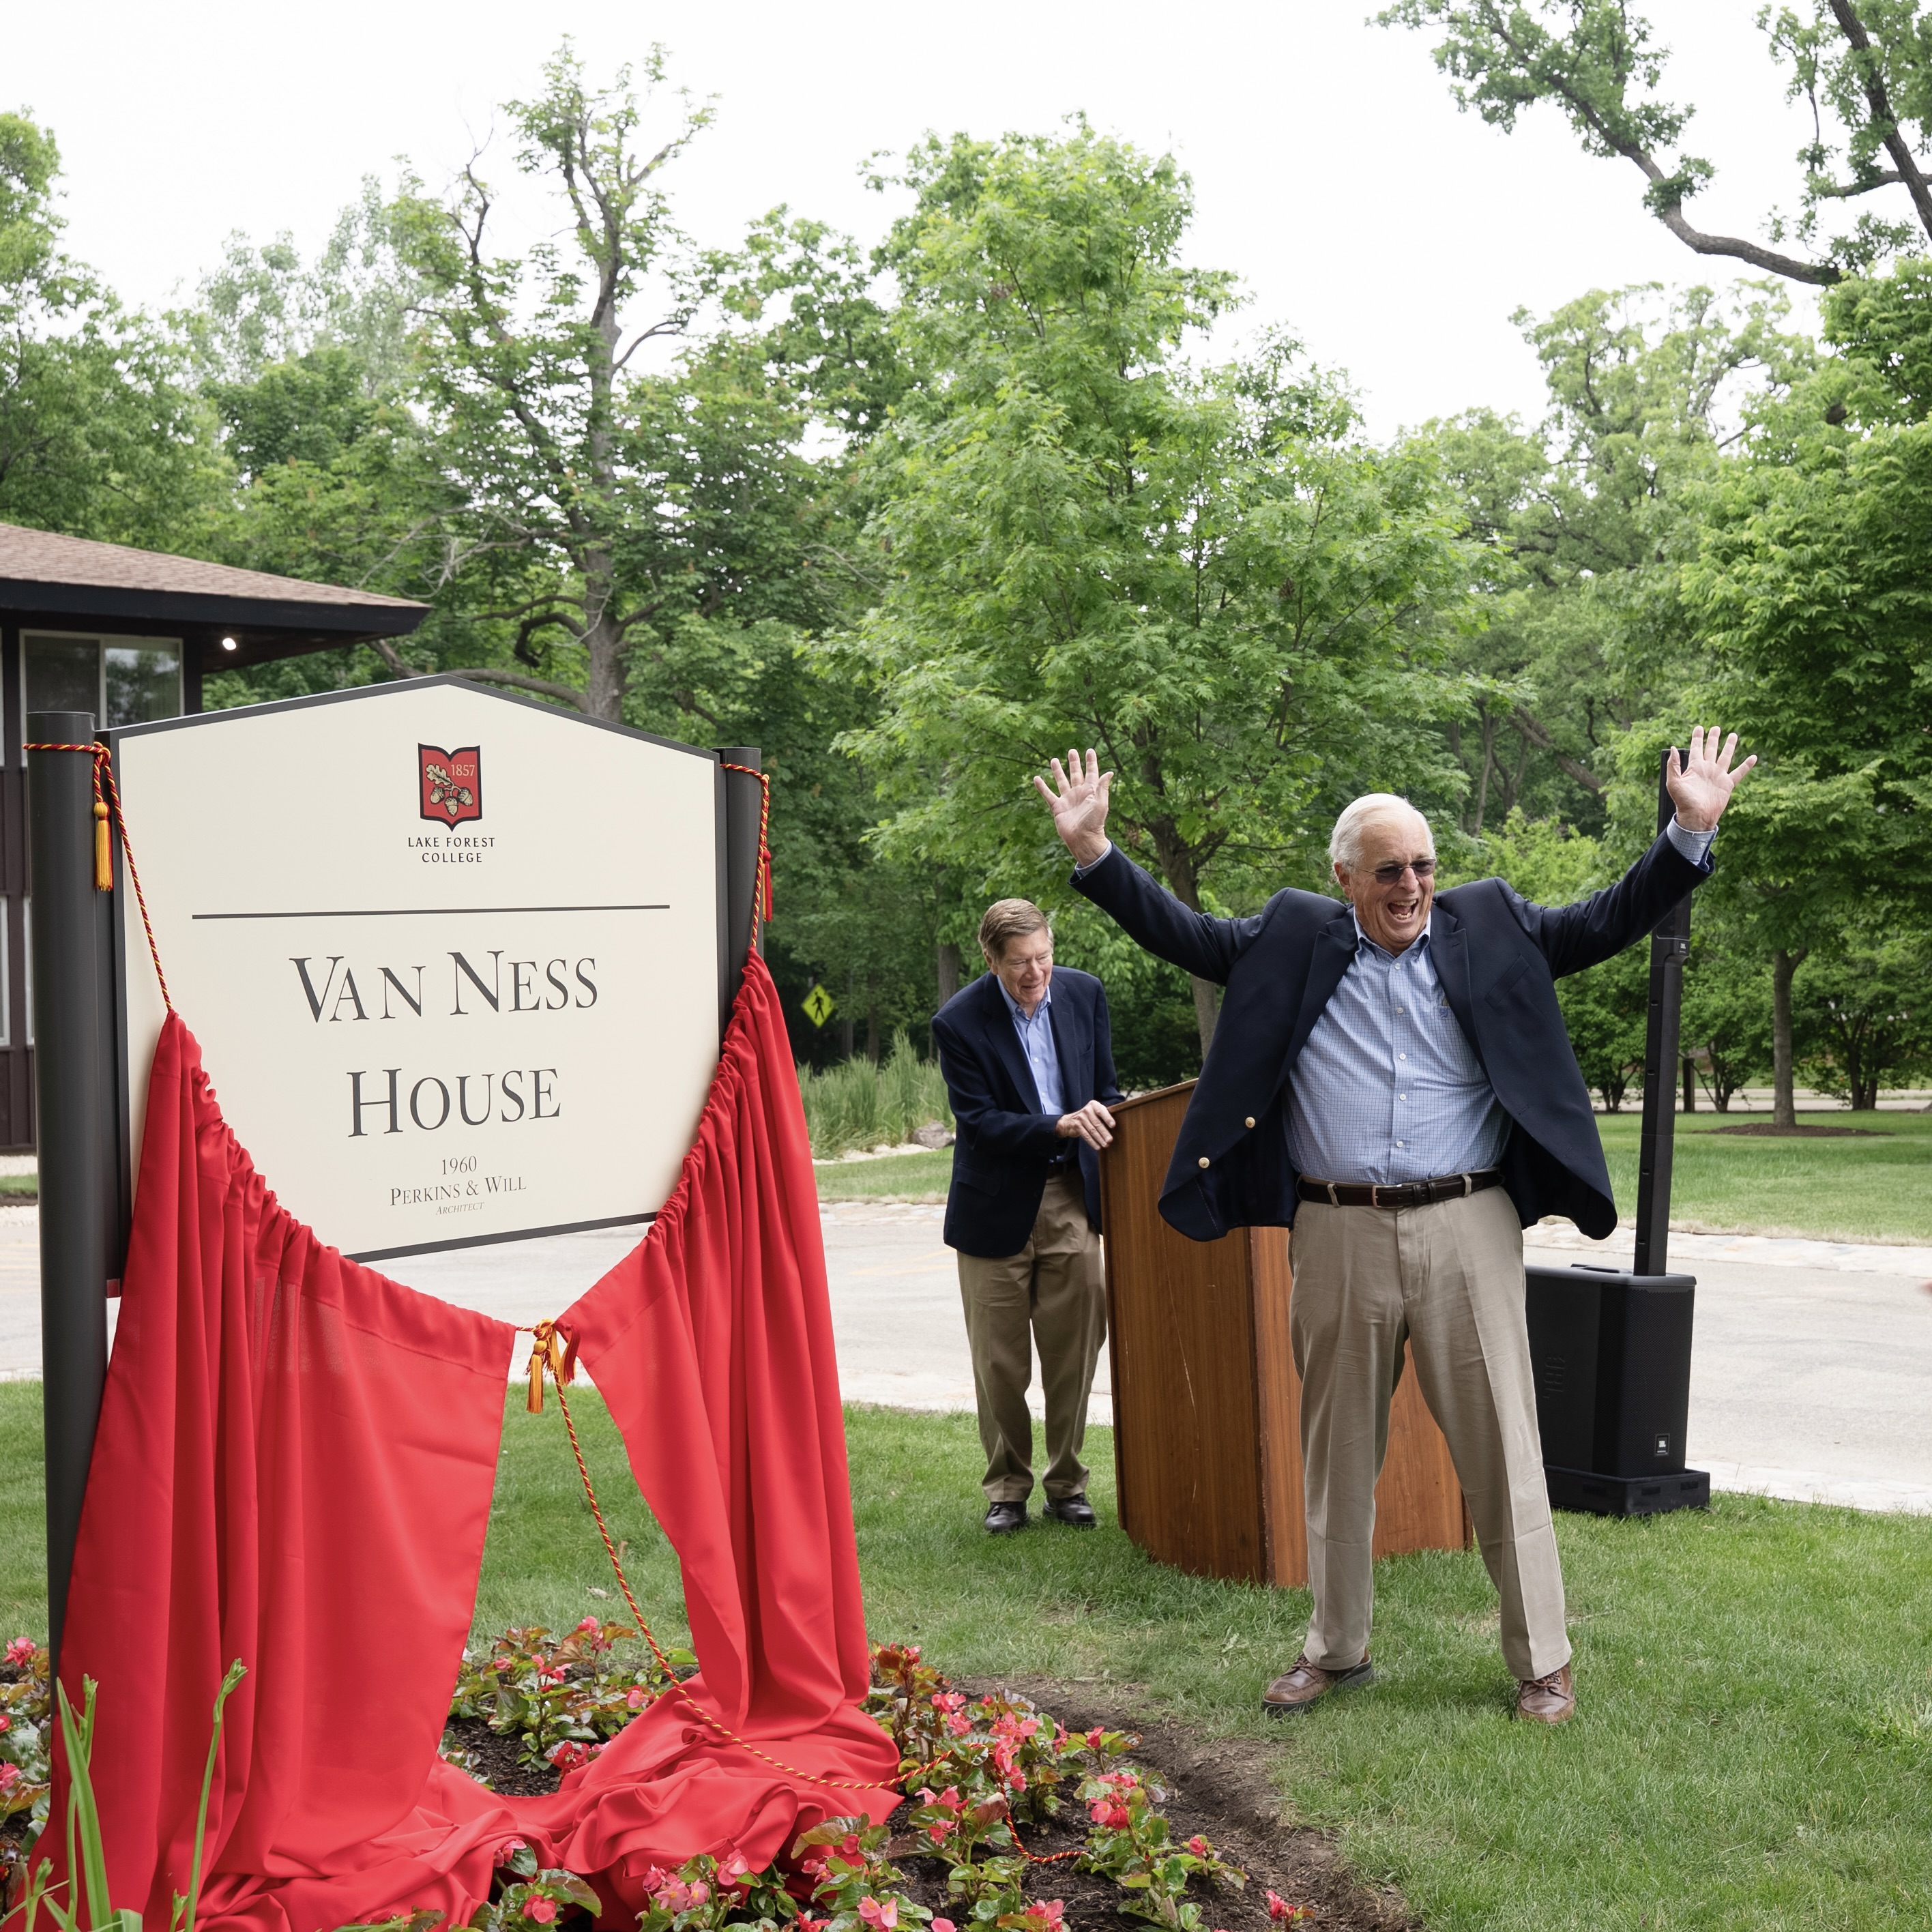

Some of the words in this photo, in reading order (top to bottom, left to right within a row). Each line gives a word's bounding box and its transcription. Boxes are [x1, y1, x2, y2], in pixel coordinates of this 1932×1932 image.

[451, 764, 475, 776] 1857
[409, 837, 439, 847] LAKE
[446, 837, 495, 847] FOREST
[422, 853, 482, 862] COLLEGE
[289, 956, 426, 1023] VAN
[447, 950, 597, 1015] NESS
[346, 1068, 561, 1137] HOUSE
[442, 1156, 476, 1175] 1960
[390, 1184, 460, 1206] PERKINS
[467, 1180, 479, 1196] &
[484, 1176, 526, 1193] WILL
[436, 1202, 484, 1215] ARCHITECT
